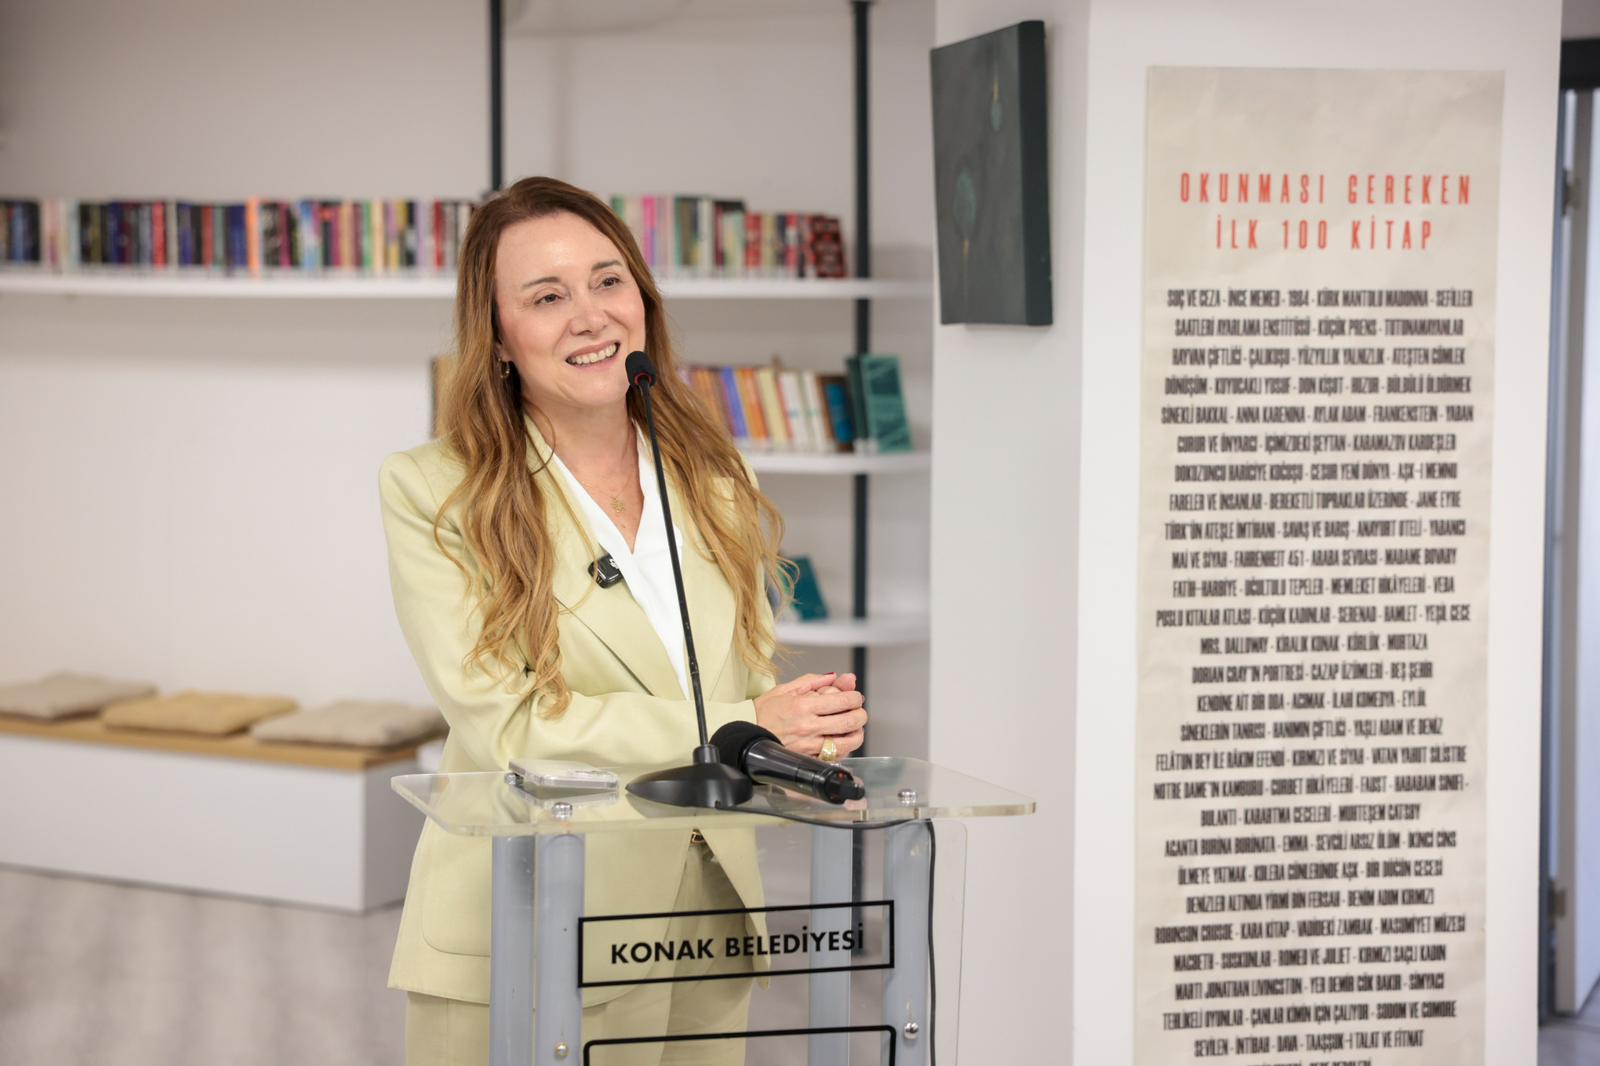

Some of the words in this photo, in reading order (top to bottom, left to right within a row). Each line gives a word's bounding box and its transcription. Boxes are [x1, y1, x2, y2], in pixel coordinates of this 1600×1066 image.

[1181, 172, 1324, 204] OKUNMASI
[1347, 175, 1470, 204] GEREKEN
[1216, 215, 1258, 249] İLK
[1282, 219, 1327, 250] 100
[1351, 216, 1431, 250] KİTAP
[1186, 288, 1196, 306] VE
[1207, 435, 1217, 452] VE
[1207, 493, 1216, 510] VE
[1312, 520, 1321, 537] VE
[1190, 551, 1200, 568] VE
[1288, 549, 1304, 566] 451
[1405, 717, 1415, 735] VE
[1327, 748, 1336, 765] VE
[611, 938, 714, 965] KONAK
[725, 923, 864, 957] BELEDİYESİ
[1310, 947, 1319, 965] VE
[1408, 1001, 1419, 1018] VE
[1381, 1030, 1392, 1048] VE
